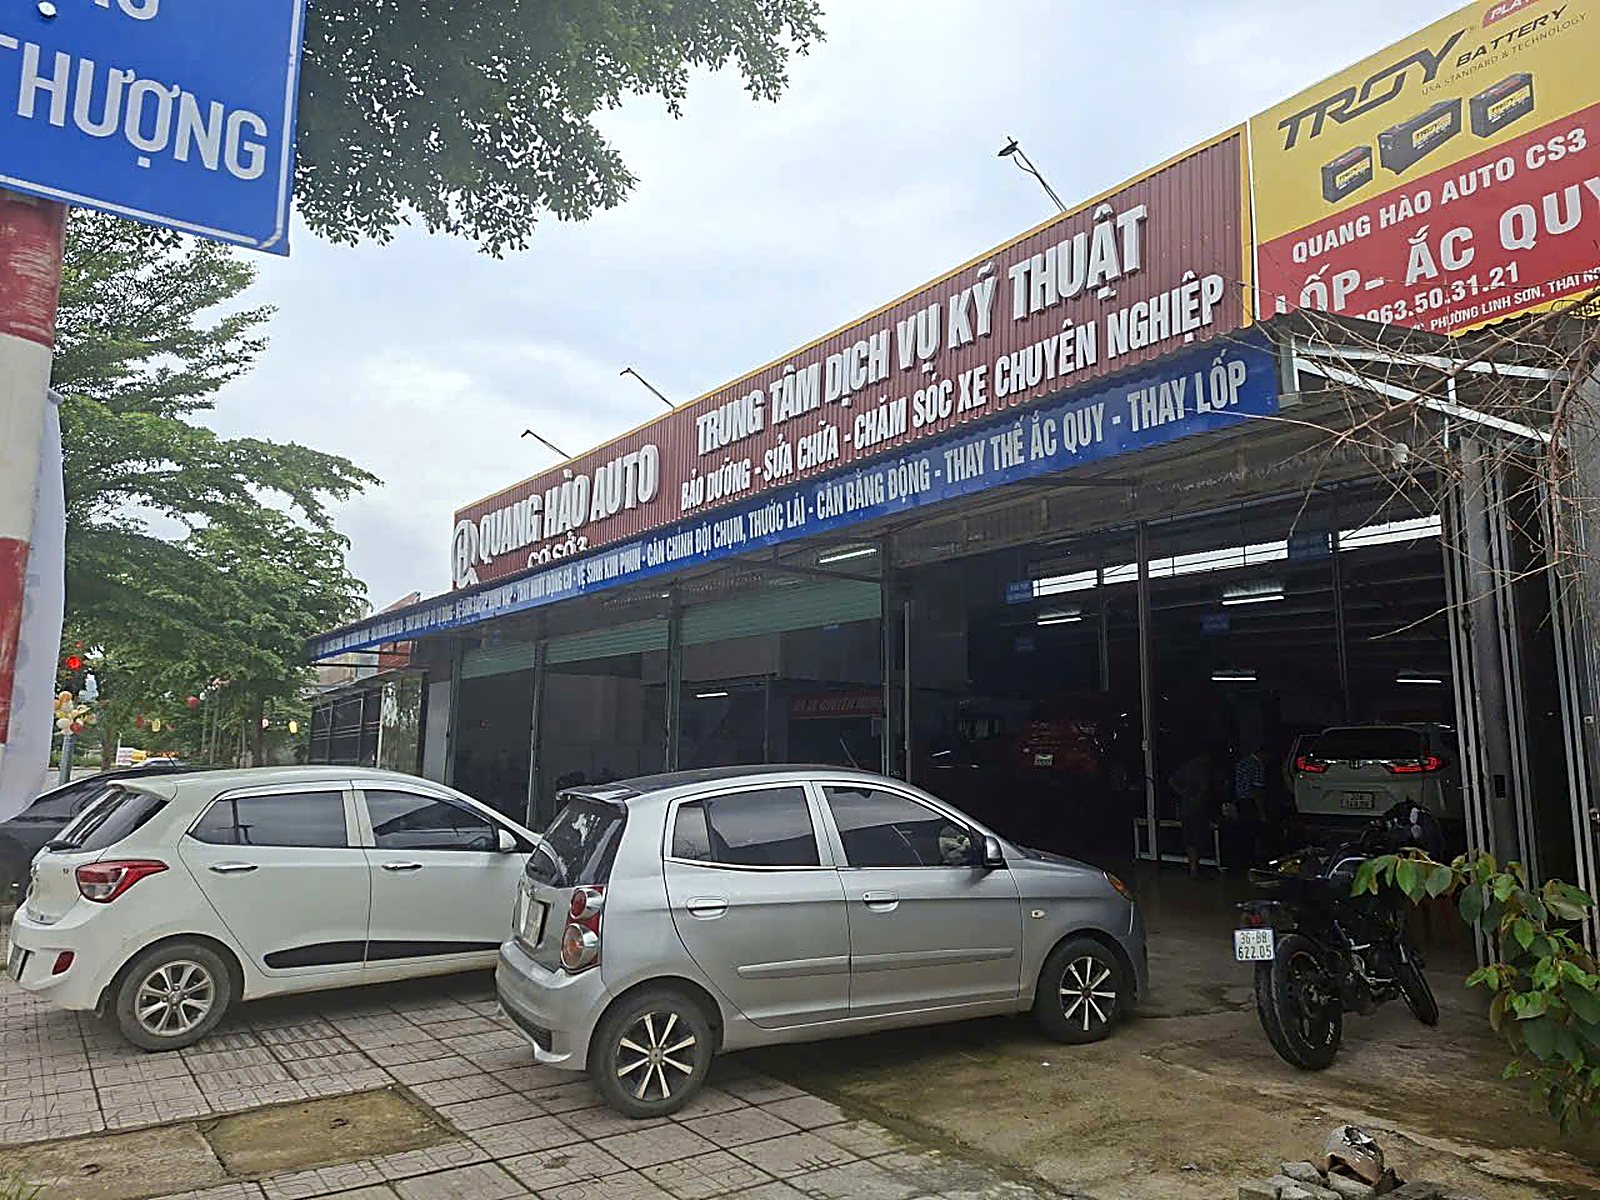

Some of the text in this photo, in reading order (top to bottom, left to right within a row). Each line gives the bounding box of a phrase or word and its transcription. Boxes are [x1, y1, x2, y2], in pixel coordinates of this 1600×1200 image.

[1278, 28, 1466, 150] TROY
[1456, 5, 1567, 67] BATTERY
[1293, 128, 1586, 263] QUANG HÀO AUTO CS3
[1405, 225, 1474, 286] ẮC
[698, 203, 1147, 456] TRUNG TÂM DỊCH VỤ KỸ THUẬT
[1354, 261, 1519, 325] 963.50.31.21
[1481, 296, 1511, 315] LINH
[681, 468, 704, 512] BẢO
[706, 456, 751, 502] DƯỠNG
[763, 433, 793, 482] SỬA
[797, 420, 839, 471] CHỮA
[854, 397, 907, 450] CHĂM
[912, 372, 953, 428] SÓC
[957, 364, 988, 413] XE
[995, 318, 1097, 397] CHUYÊN
[1107, 270, 1225, 359] NGHIỆP
[748, 498, 784, 538] THƯỚC
[786, 492, 806, 528] LÁI
[817, 484, 845, 519] CÂN
[846, 469, 884, 513] BẰNG
[888, 457, 931, 503] ĐỘNG
[945, 440, 985, 481] THAY
[990, 416, 1025, 471] THẾ
[1030, 410, 1057, 462] ẮC
[1064, 403, 1105, 453] QUY
[1127, 377, 1187, 432] THAY
[1194, 349, 1246, 414] LỐP
[479, 494, 543, 566] QUANG
[544, 469, 590, 538] HÀO
[590, 444, 660, 523] AUTO
[1238, 944, 1272, 960] 622.05
